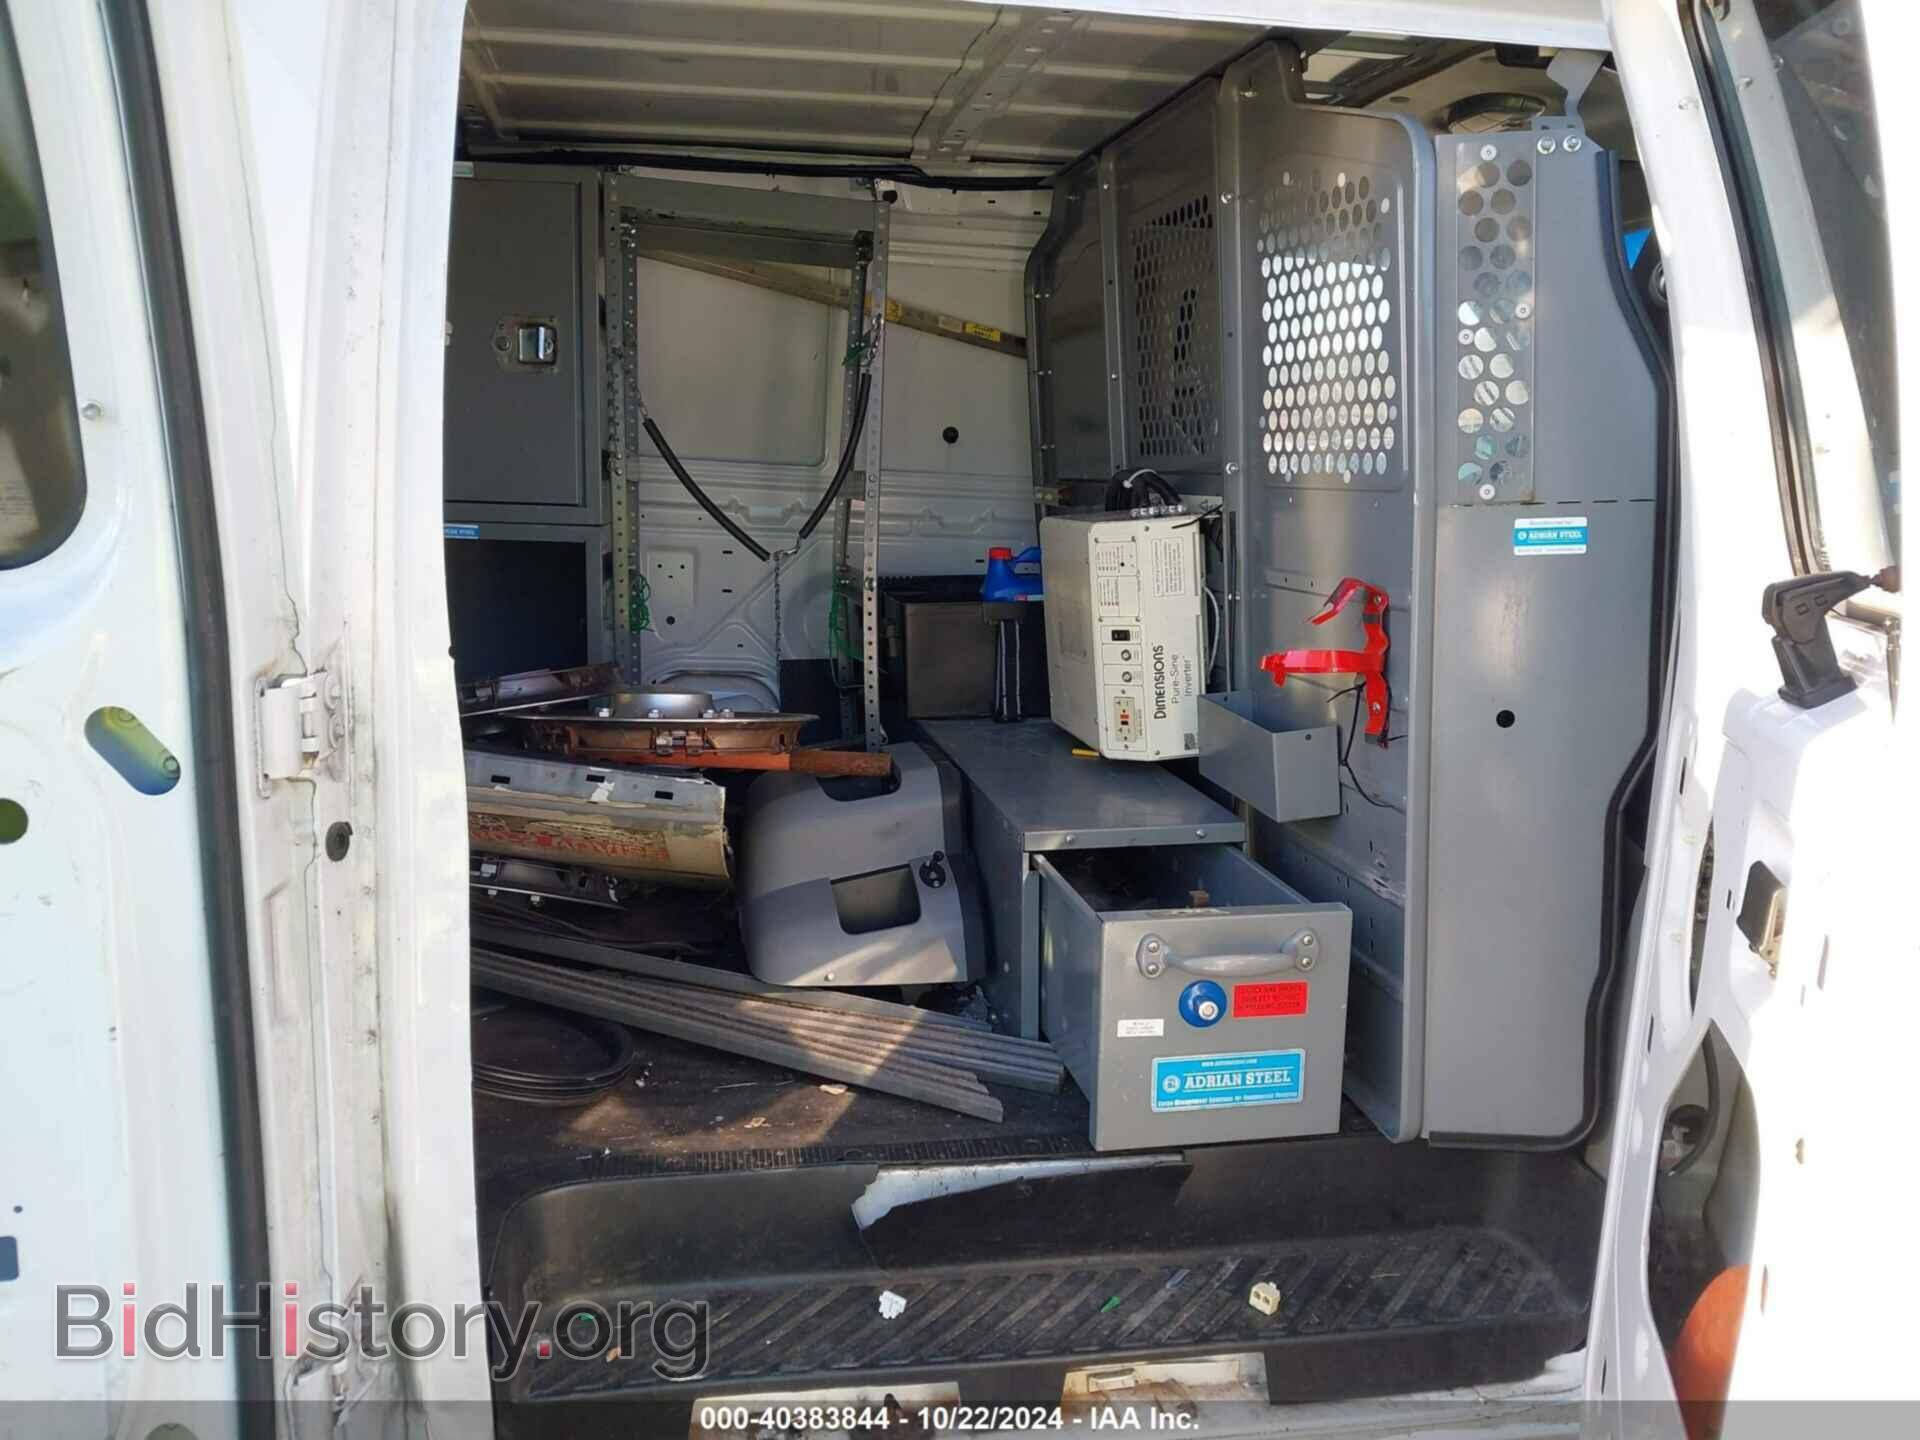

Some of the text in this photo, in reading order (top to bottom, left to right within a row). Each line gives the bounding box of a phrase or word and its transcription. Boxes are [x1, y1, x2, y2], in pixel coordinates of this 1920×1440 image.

[1170, 654, 1181, 704] Pure-Sine
[1184, 1070, 1291, 1089] ADRIAN STEEL
